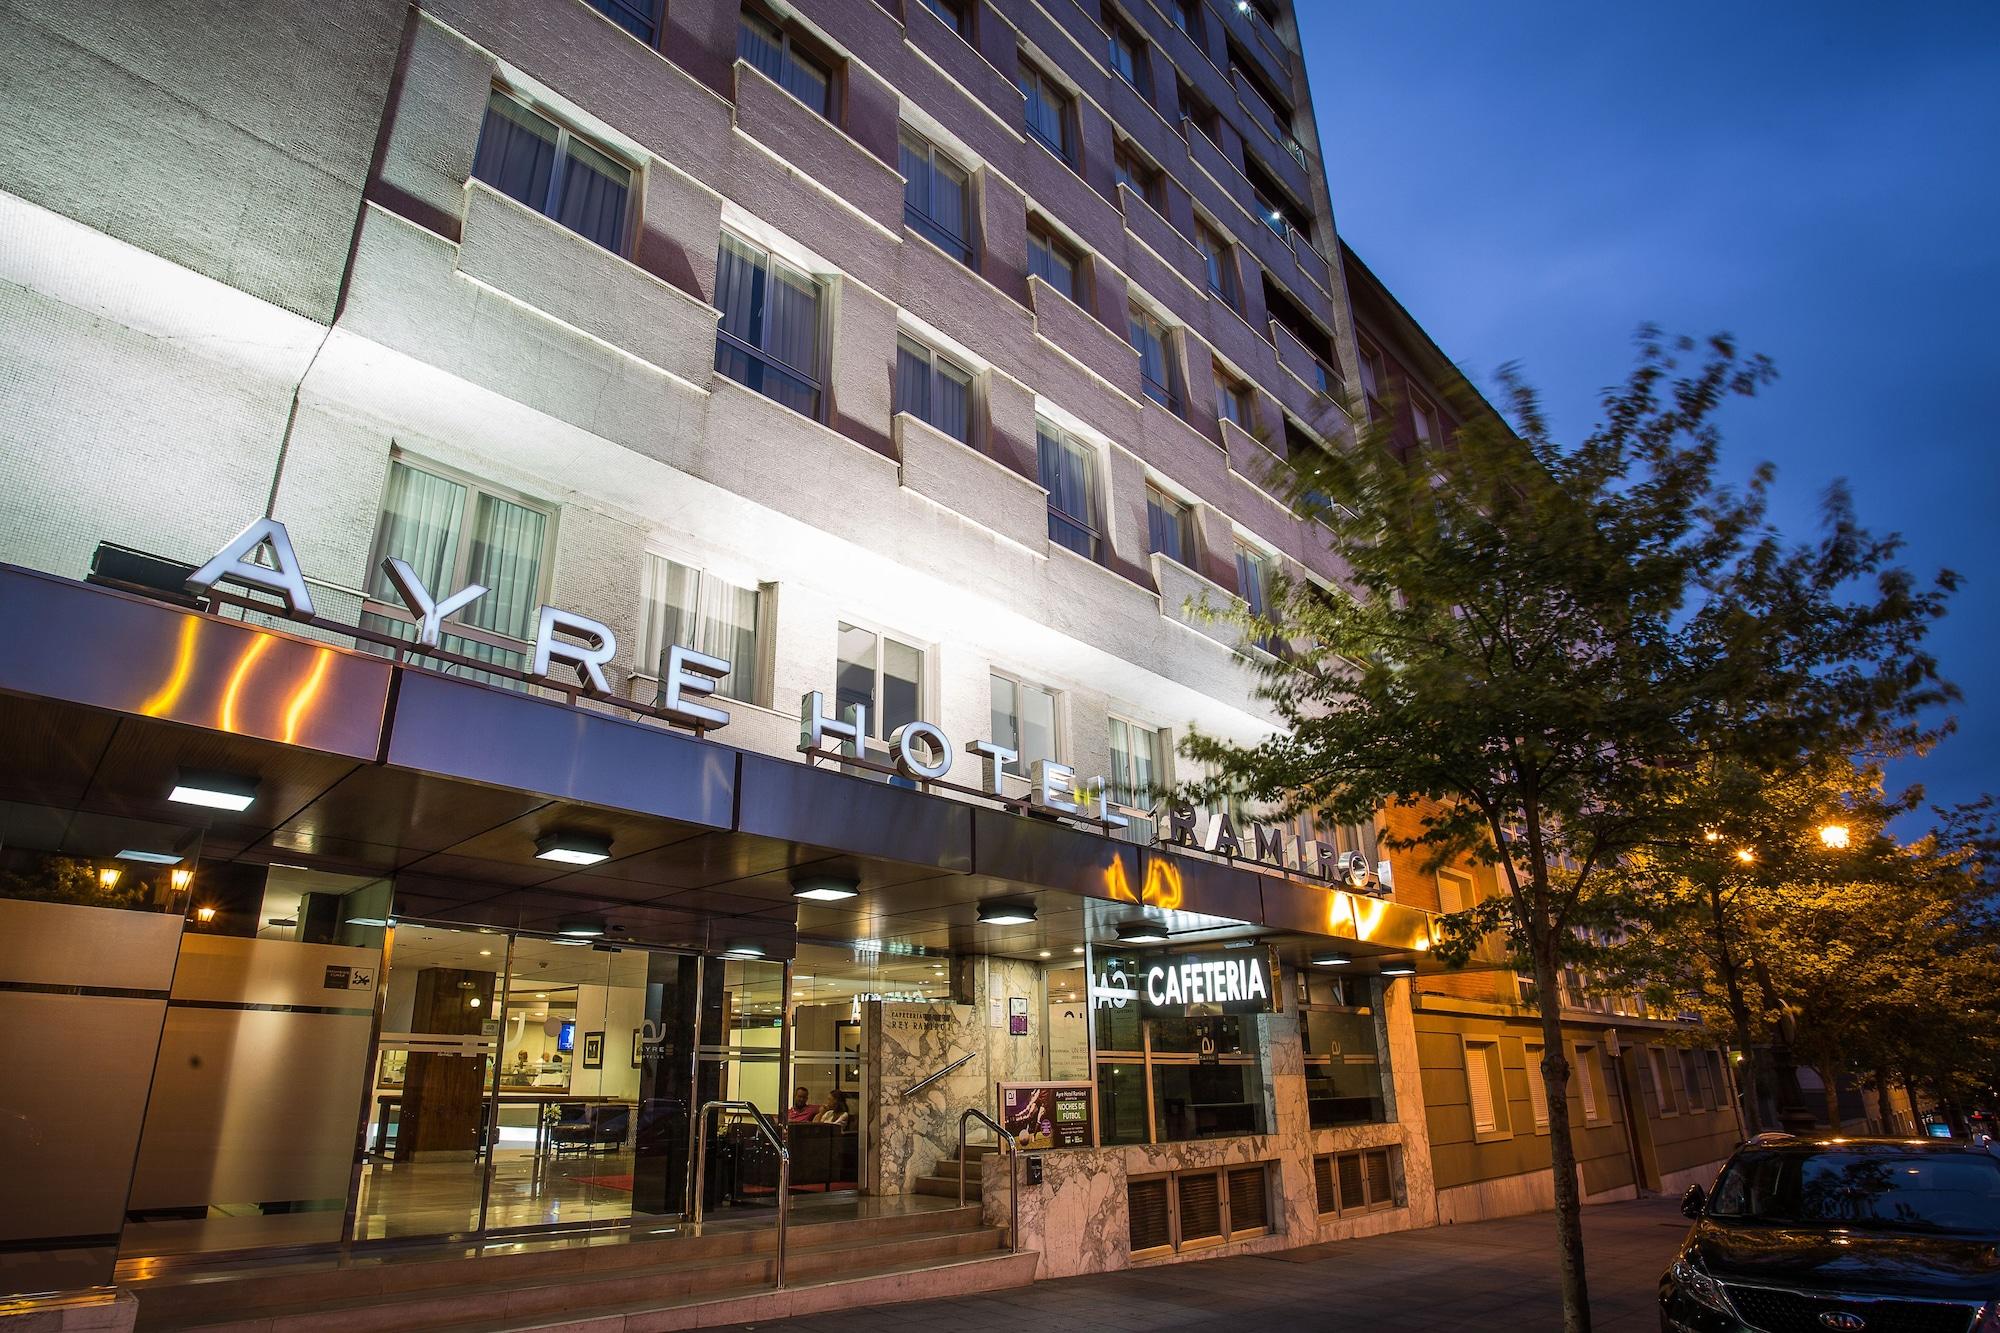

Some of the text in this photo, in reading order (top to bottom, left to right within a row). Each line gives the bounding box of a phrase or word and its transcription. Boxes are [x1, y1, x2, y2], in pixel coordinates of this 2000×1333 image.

[186, 516, 731, 731] AYRE
[801, 690, 1128, 829] HOTEL
[1160, 803, 1370, 888] RAMIRO
[1148, 958, 1267, 1006] CAFETERIA
[892, 1021, 909, 1030] REY
[1057, 1103, 1077, 1111] NOCHES
[1062, 1111, 1081, 1120] FÚTBOL
